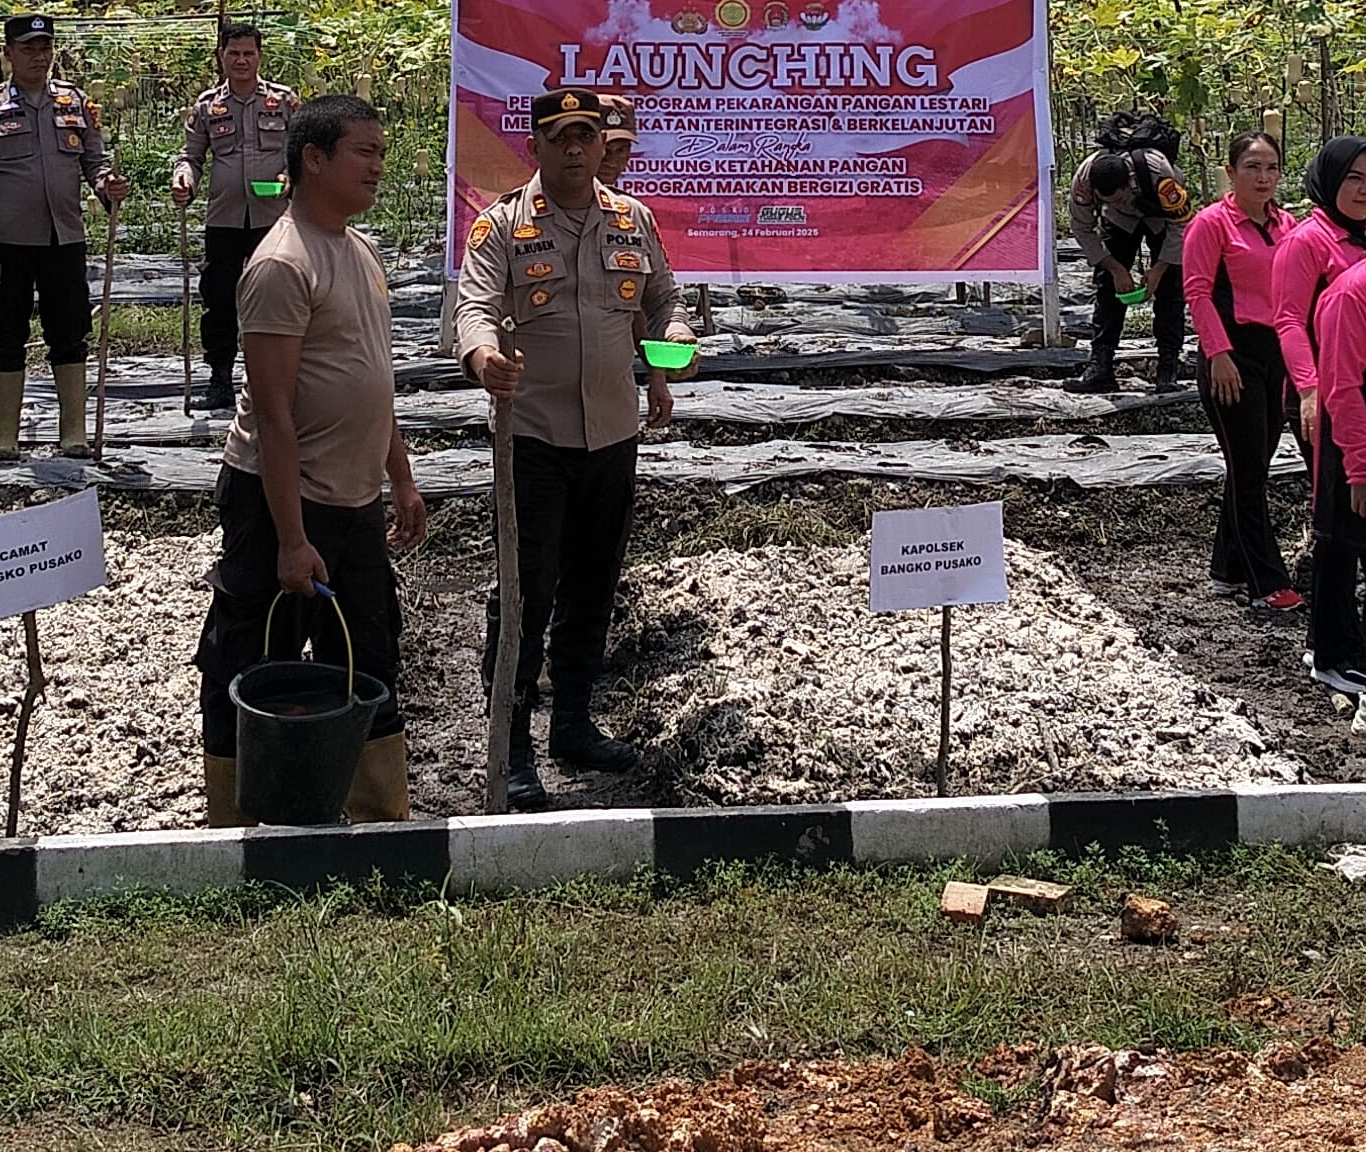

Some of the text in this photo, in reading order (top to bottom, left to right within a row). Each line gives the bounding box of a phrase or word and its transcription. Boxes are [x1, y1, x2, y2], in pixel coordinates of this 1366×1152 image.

[558, 43, 939, 89] LAUNCHING
[623, 96, 712, 111] ROGRAM
[715, 96, 838, 111] PEKARANGAN
[841, 96, 916, 111] PANGAN
[920, 96, 987, 111] LESTARI
[703, 117, 827, 132] TERINTEGRASI
[831, 117, 843, 131] &
[846, 117, 993, 132] BERKELANJUTAN
[674, 131, 812, 169] Dalam Rangka
[623, 159, 905, 173] NDUKUNG KETAHANAN PANGAN
[622, 180, 712, 194] PROGRAM
[716, 180, 784, 194] MAKAN
[787, 180, 854, 194] BERGIZI
[857, 180, 921, 194] GRATIS
[606, 233, 642, 247] POLRI
[687, 228, 819, 238] Semarang, 24 Februari 2025
[900, 540, 965, 556] KAPOLSEK
[29, 549, 83, 574] PUSAKO
[880, 555, 982, 576] BANGKO PUSAKO
